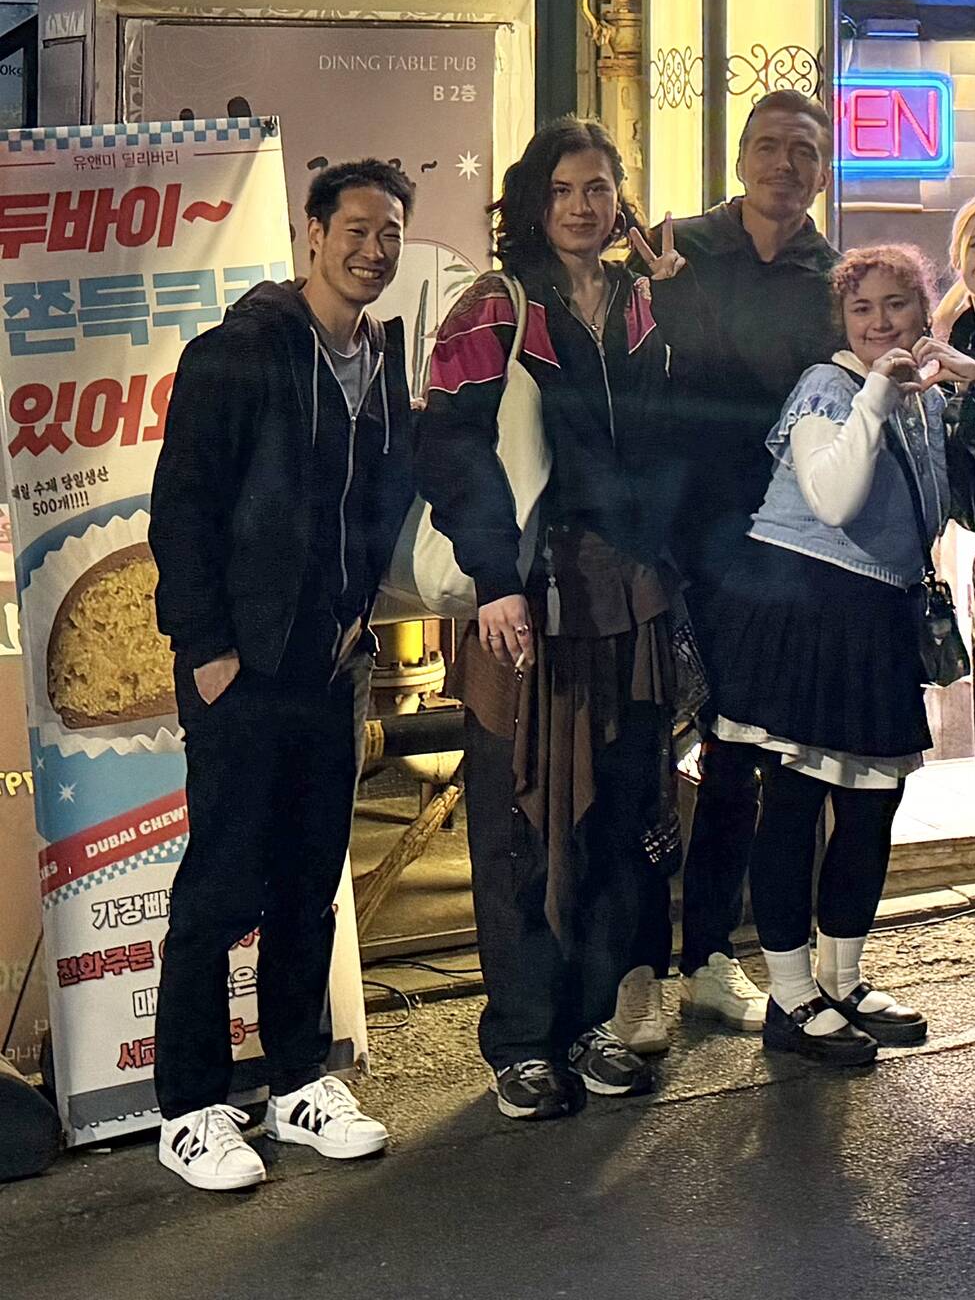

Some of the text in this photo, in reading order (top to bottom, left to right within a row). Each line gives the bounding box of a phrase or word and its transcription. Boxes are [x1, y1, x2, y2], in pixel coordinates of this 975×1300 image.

[319, 54, 477, 72] DINING TABLE PUB
[433, 84, 477, 102] B 2층
[73, 150, 180, 171] 유앤미 딜리버리
[34, 476, 58, 495] 수제
[61, 466, 109, 490] 당일생산
[85, 804, 189, 859] DUBAI CHEW
[92, 887, 174, 931] 가장빠
[57, 940, 154, 987] 전화주문
